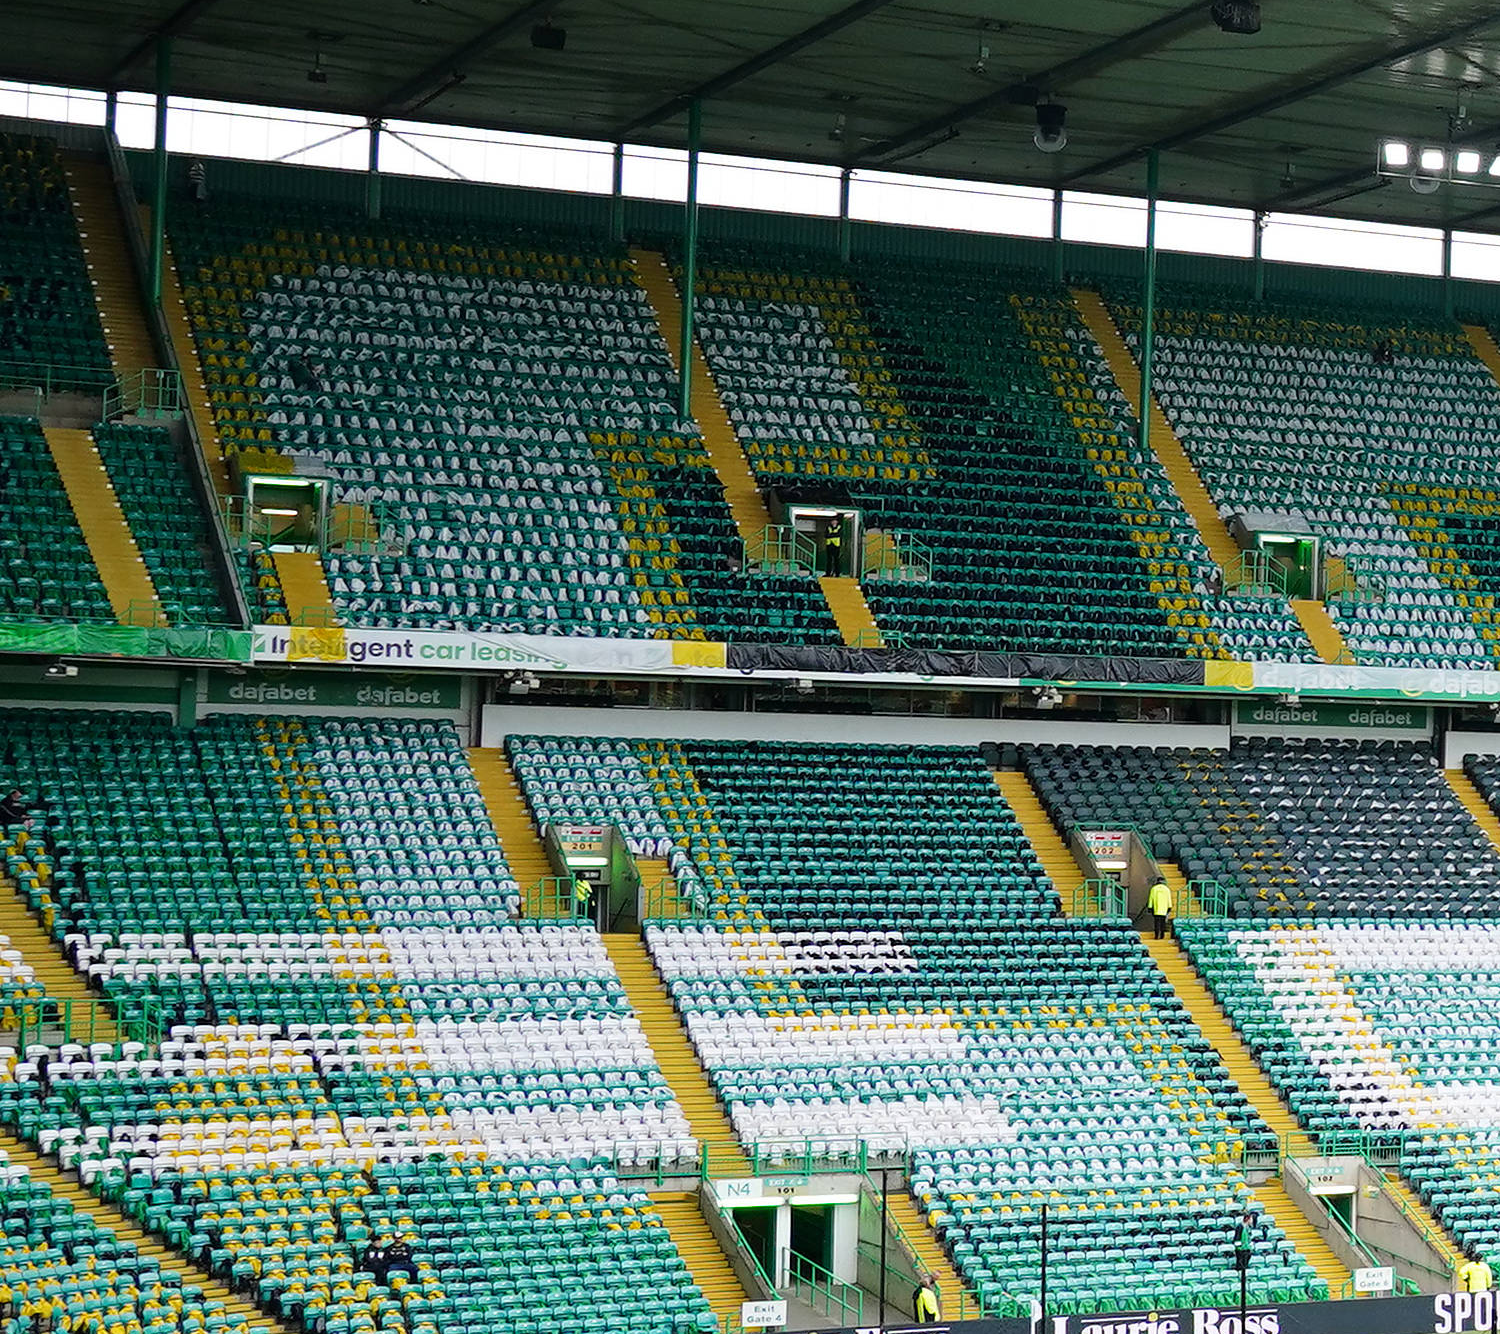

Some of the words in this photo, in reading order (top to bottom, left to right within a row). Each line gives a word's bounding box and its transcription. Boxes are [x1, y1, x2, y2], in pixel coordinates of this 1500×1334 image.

[272, 634, 413, 663] Intelligent
[420, 642, 465, 660] car
[230, 683, 317, 702] dafabet
[357, 686, 441, 706] dafabet
[1252, 707, 1318, 723] dafabet
[1348, 710, 1412, 726] dafabet
[572, 842, 592, 850] 201
[727, 1181, 751, 1199] N4
[754, 1305, 775, 1313] Exit
[747, 1315, 773, 1325] Gate
